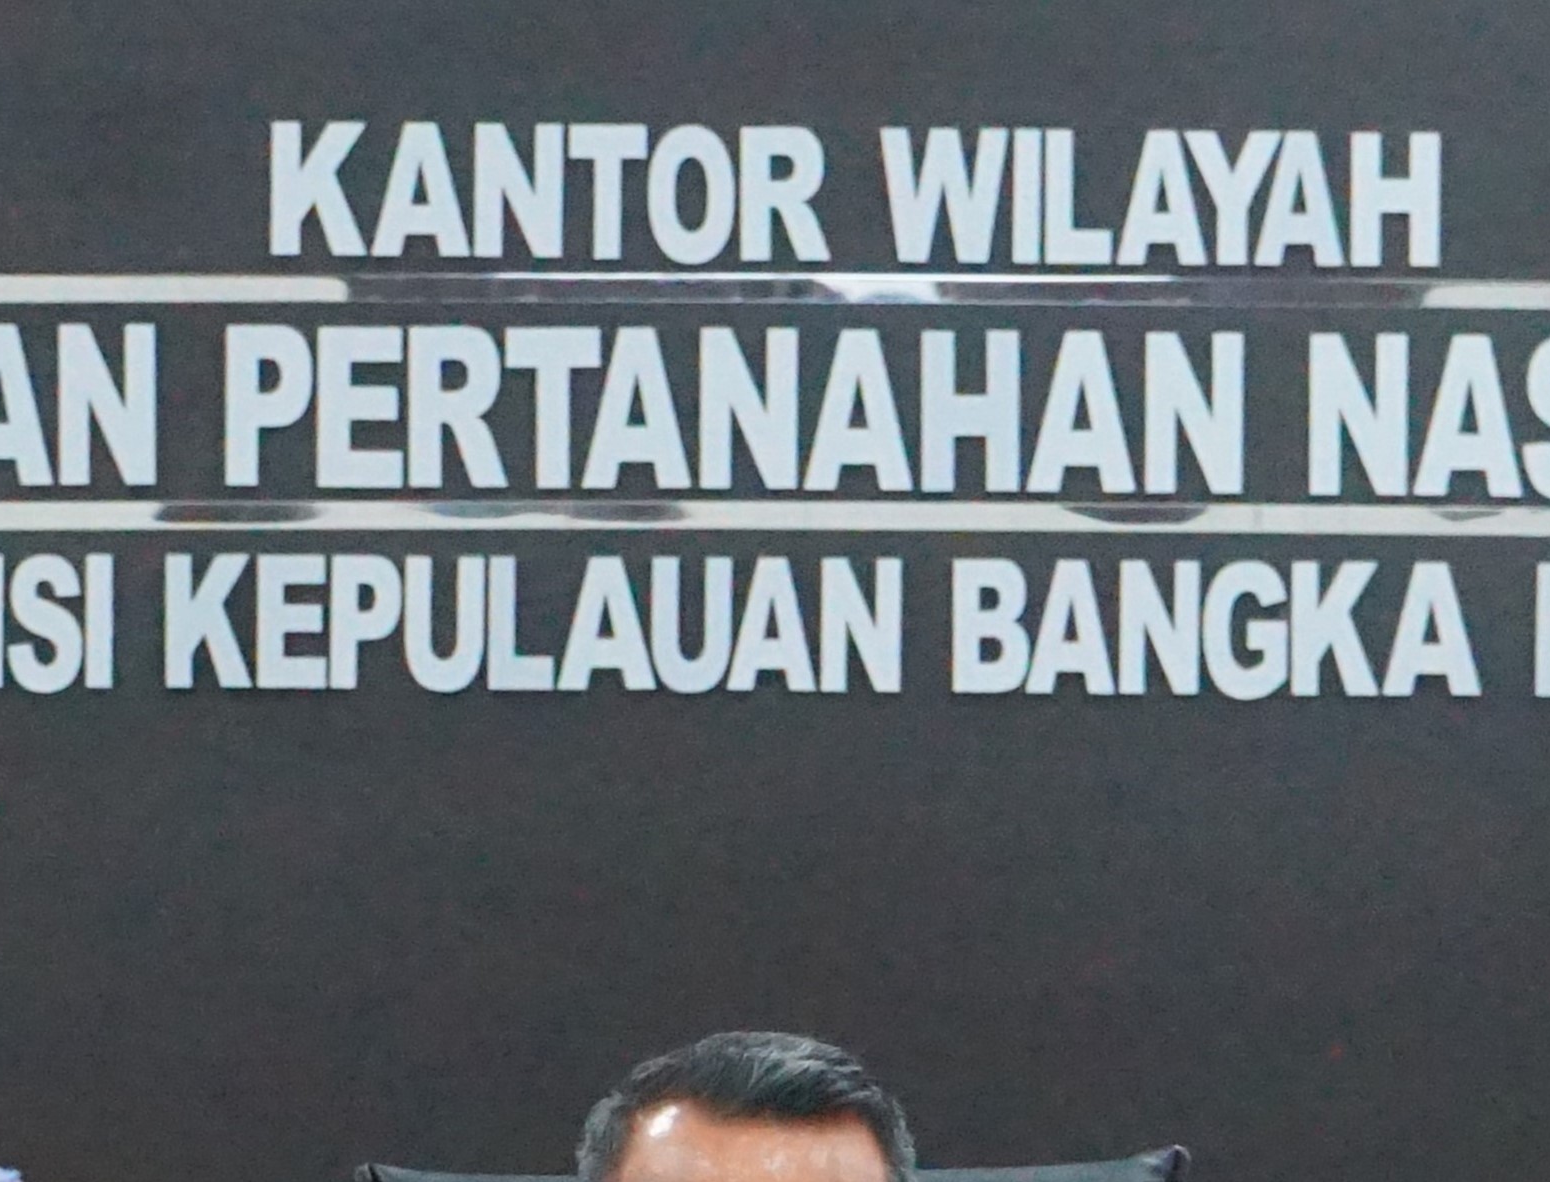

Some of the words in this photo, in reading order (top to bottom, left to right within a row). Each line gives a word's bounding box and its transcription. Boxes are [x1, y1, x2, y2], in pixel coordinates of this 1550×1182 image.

[269, 120, 831, 264] KANTOR
[879, 126, 1442, 268] WILAYAH
[224, 323, 1245, 495] PERTANAHAN
[164, 552, 903, 693] KEPULAUAN
[951, 557, 1482, 701] BANGKA
